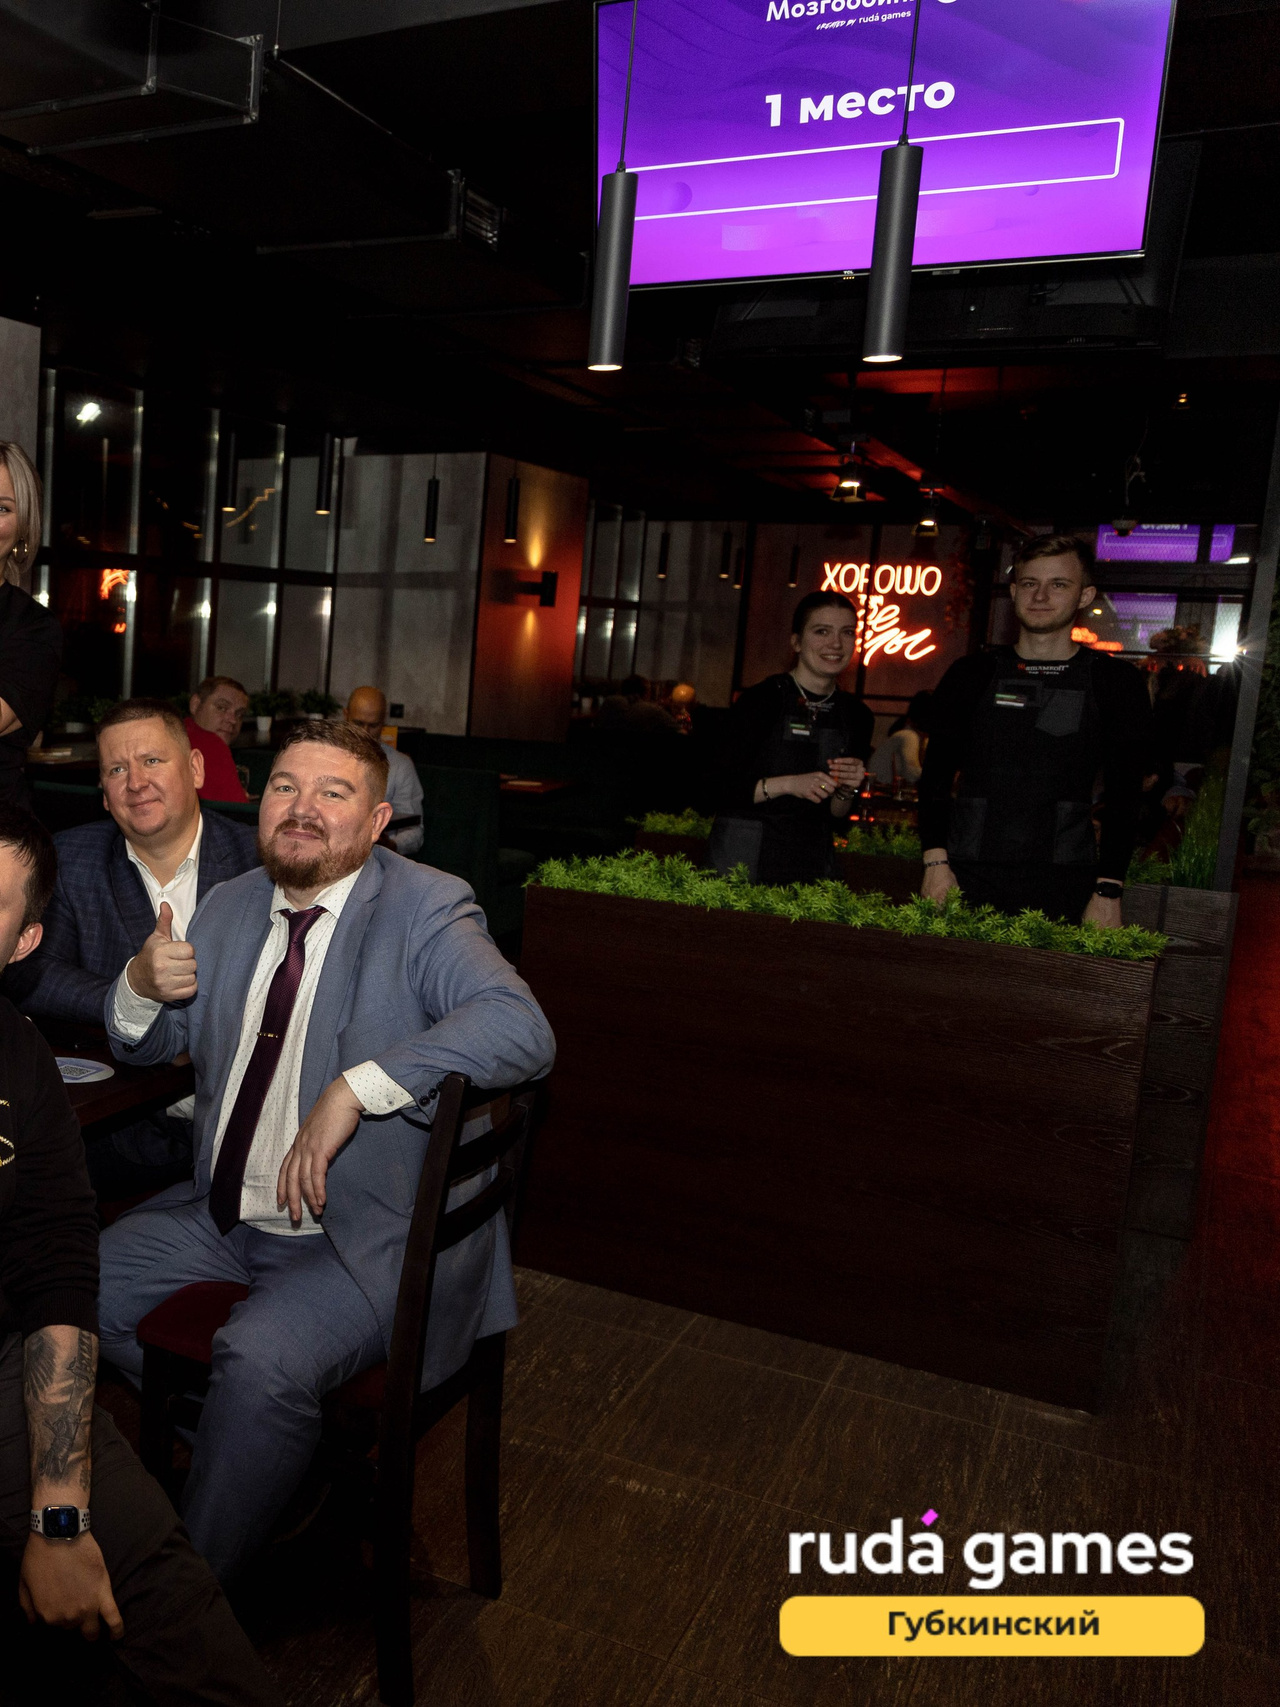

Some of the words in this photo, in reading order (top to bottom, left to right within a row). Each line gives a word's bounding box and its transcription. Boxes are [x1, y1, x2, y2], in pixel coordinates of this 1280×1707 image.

[766, 0, 915, 21] Мозгобо
[881, 11, 912, 22] games
[765, 94, 782, 127] 1
[799, 81, 956, 124] место
